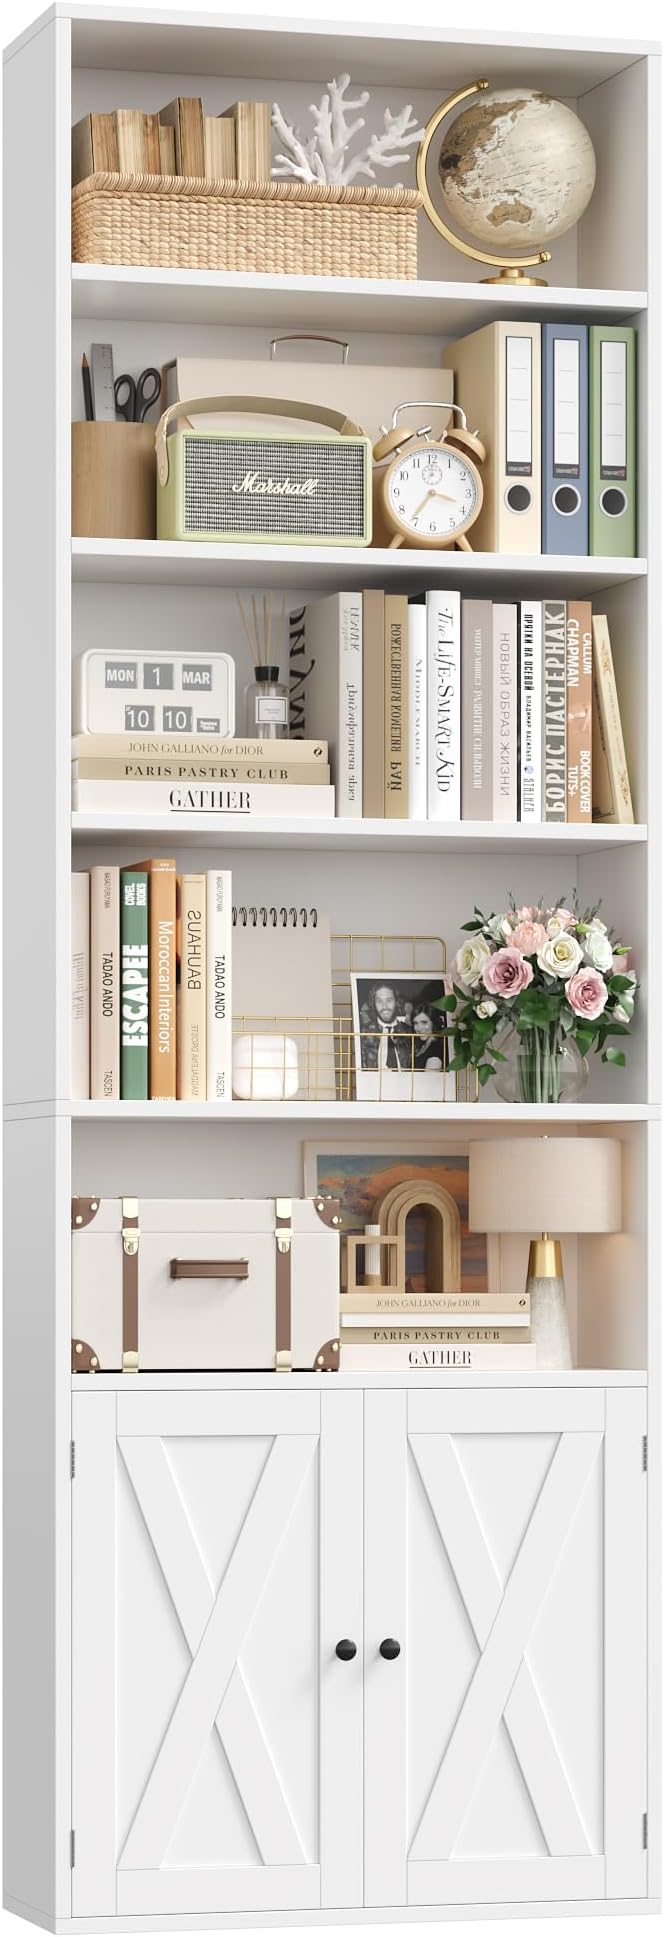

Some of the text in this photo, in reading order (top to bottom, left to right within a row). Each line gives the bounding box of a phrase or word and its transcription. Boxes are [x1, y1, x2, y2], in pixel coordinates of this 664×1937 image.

[232, 471, 319, 494] Marshall
[438, 608, 453, 638] The
[524, 647, 533, 657] НА
[567, 618, 580, 687] CHAPMAN
[582, 632, 592, 675] CALLUM
[106, 669, 135, 683] MON
[152, 667, 161, 686] 1
[183, 670, 210, 685] MAR
[524, 661, 535, 691] ОСЕВОЙ
[128, 709, 150, 728] 10
[165, 711, 187, 729] 10
[500, 633, 512, 796] НОВЫЙ ОБРАЗ ЖИЗНИ
[545, 610, 565, 812] БОРИС ПАСТЕРНАК
[129, 742, 263, 756] JOHN GALLIANO for DIOR
[125, 765, 289, 780] PARIS PASTRY CLUB
[568, 765, 579, 797] TUTS+
[580, 750, 591, 813] BOOK COVER
[169, 790, 251, 809] GATHER
[102, 952, 113, 1017] TADAO ANDO
[122, 944, 148, 1047] ESCAPEE
[158, 921, 174, 1054] Moroccan Interiors
[215, 954, 226, 1019] TADAO ANDO
[376, 1299, 400, 1307] JOHN
[401, 1299, 447, 1307] GALLIANO
[373, 1332, 501, 1340] PARIS PASTRY CLUB
[408, 1350, 472, 1365] GATHER
